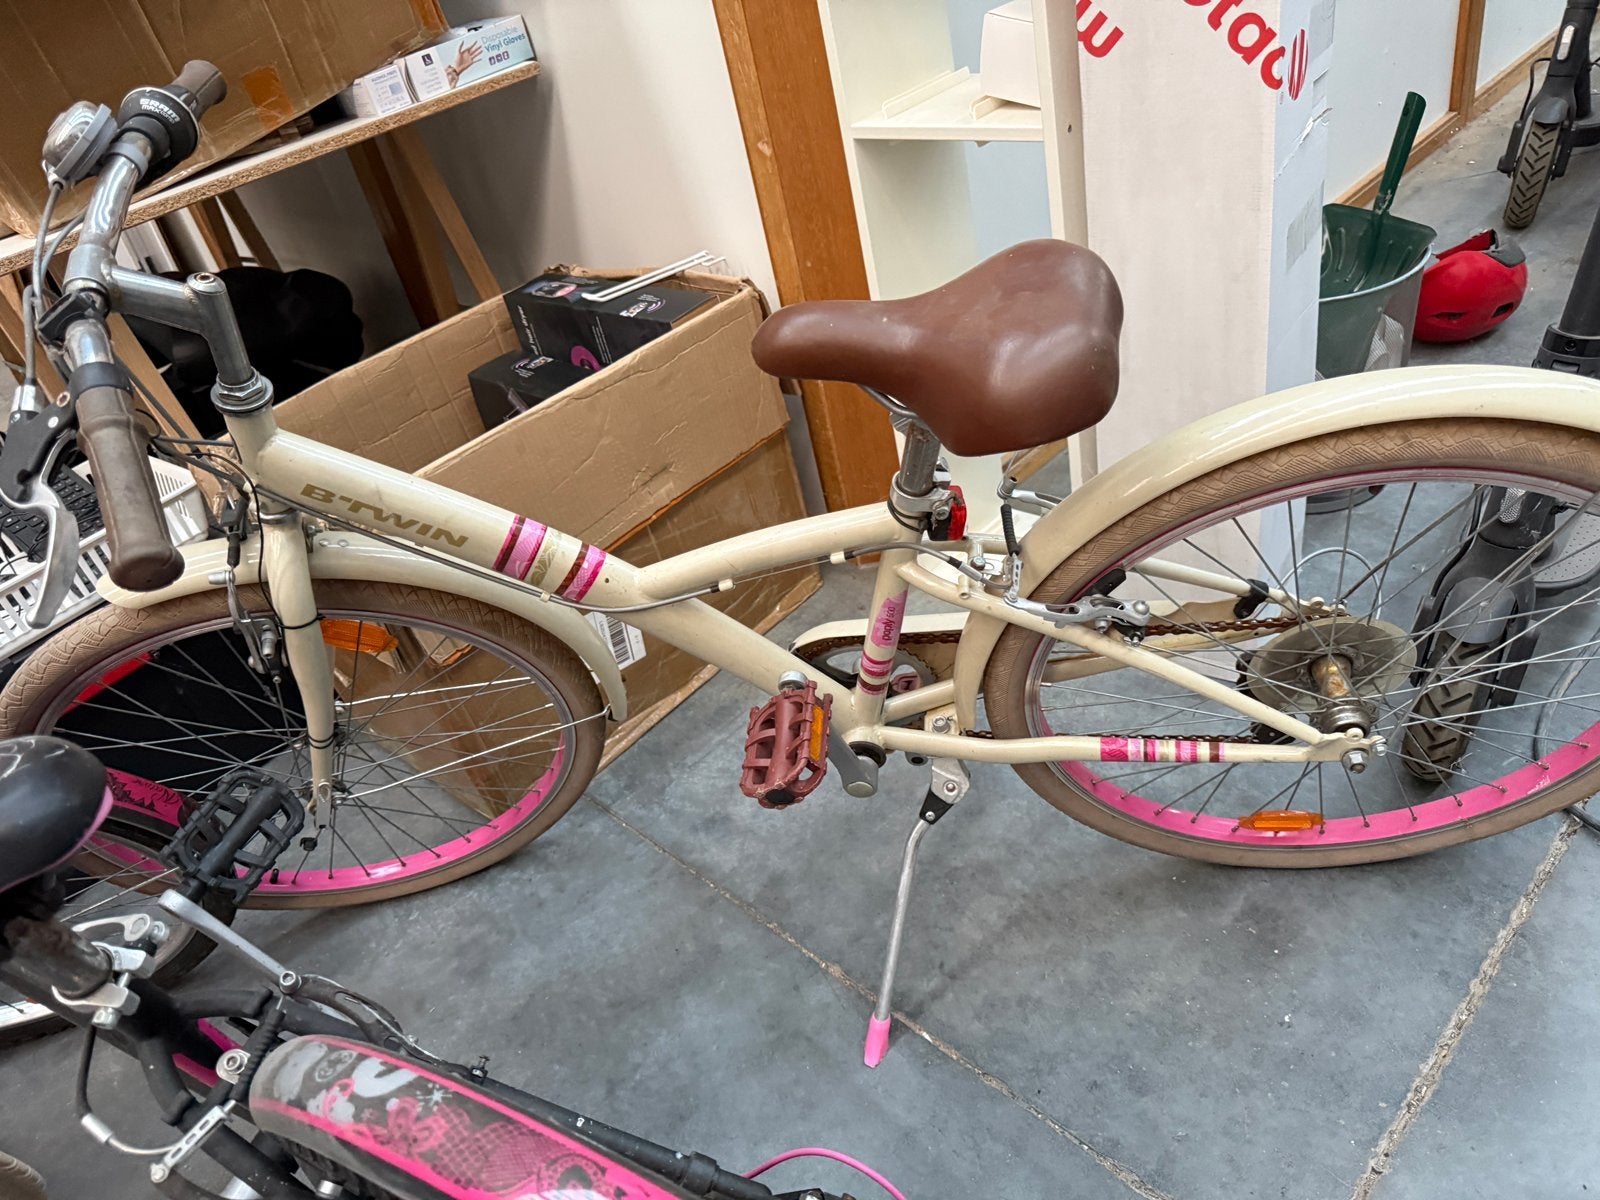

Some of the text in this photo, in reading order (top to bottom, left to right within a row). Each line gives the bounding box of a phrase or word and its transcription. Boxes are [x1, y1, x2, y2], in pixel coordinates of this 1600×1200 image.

[481, 25, 518, 44] Disposable
[484, 33, 526, 53] Vinyl Gloves
[1183, 0, 1286, 90] tac
[140, 98, 180, 122] SRAM
[300, 483, 469, 548] B'TWIN
[881, 618, 896, 641] poply
